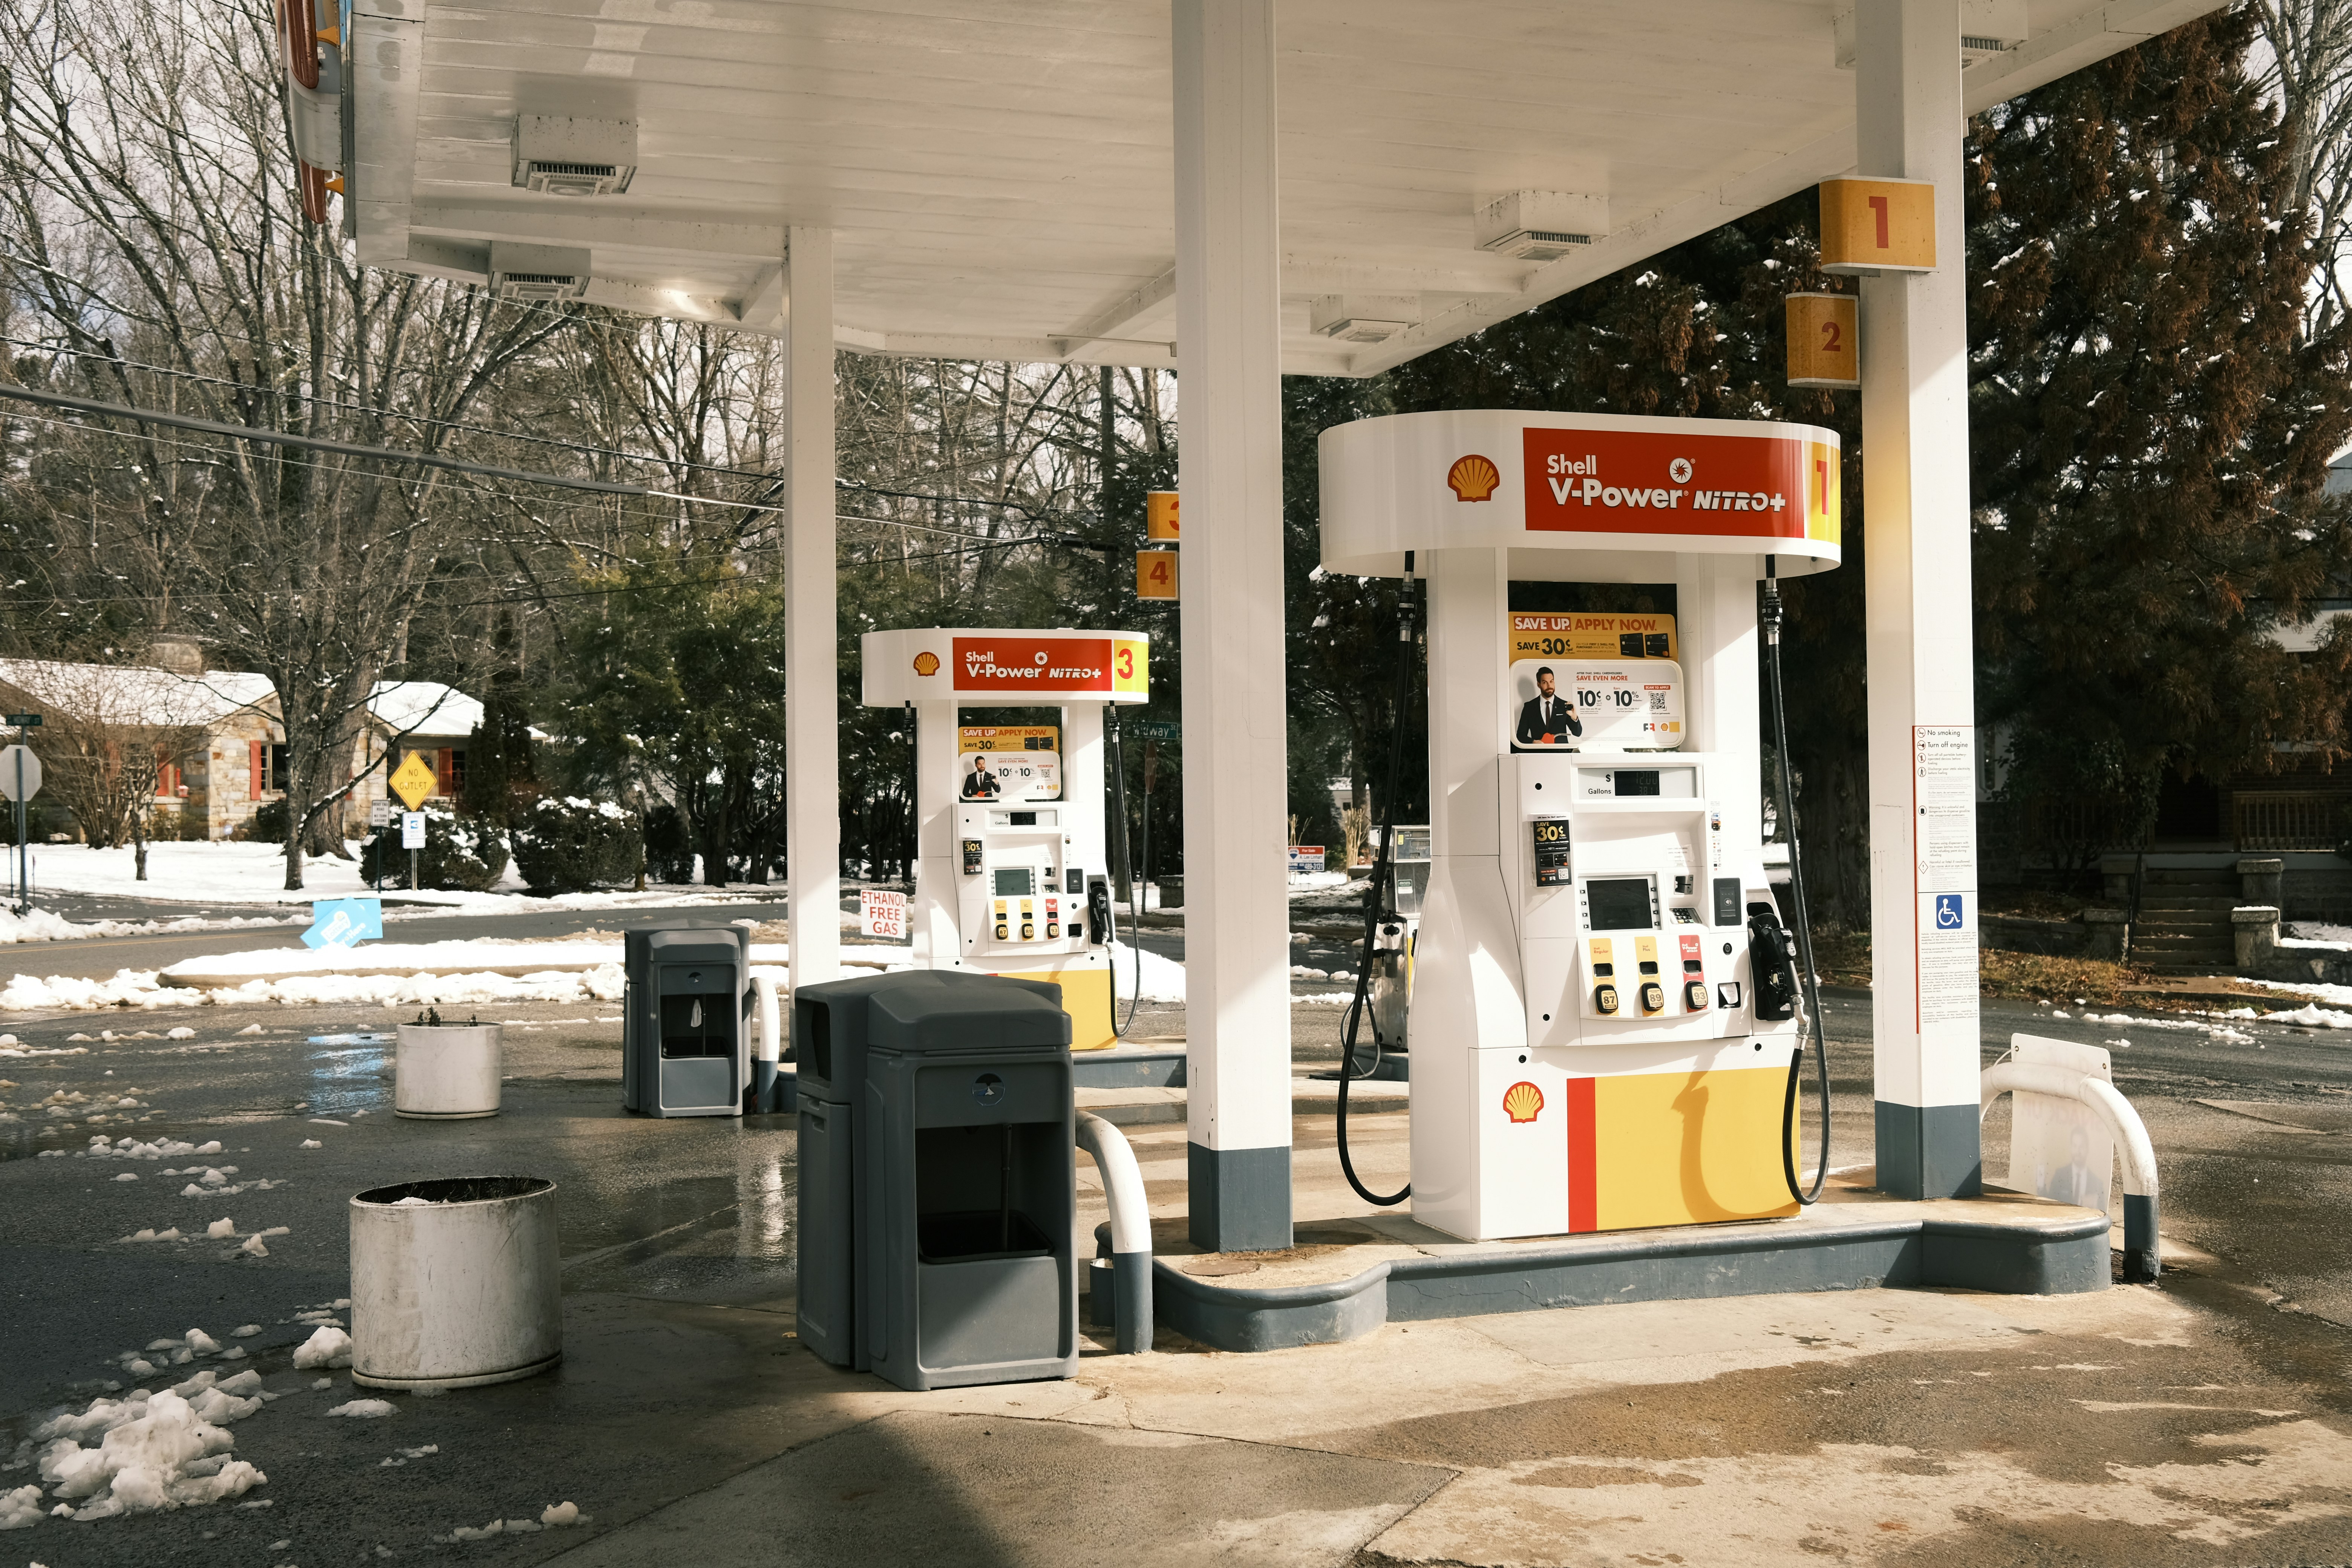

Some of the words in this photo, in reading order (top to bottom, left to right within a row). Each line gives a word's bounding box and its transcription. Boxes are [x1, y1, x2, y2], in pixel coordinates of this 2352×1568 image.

[1869, 196, 1888, 248] 1
[1822, 322, 1841, 351] 2
[1547, 455, 1596, 475] Shell
[1816, 460, 1828, 515] 1
[1150, 561, 1168, 585] 4
[1515, 618, 1547, 630] SAVE
[1551, 619, 1570, 630] UP.
[1574, 619, 1615, 630] APPLY
[1620, 620, 1657, 631] NOW.
[966, 651, 994, 662] Shell
[1117, 648, 1133, 680] 3
[862, 891, 905, 907] ETHANOL
[870, 907, 900, 921] FREE
[873, 921, 898, 935] GAS
